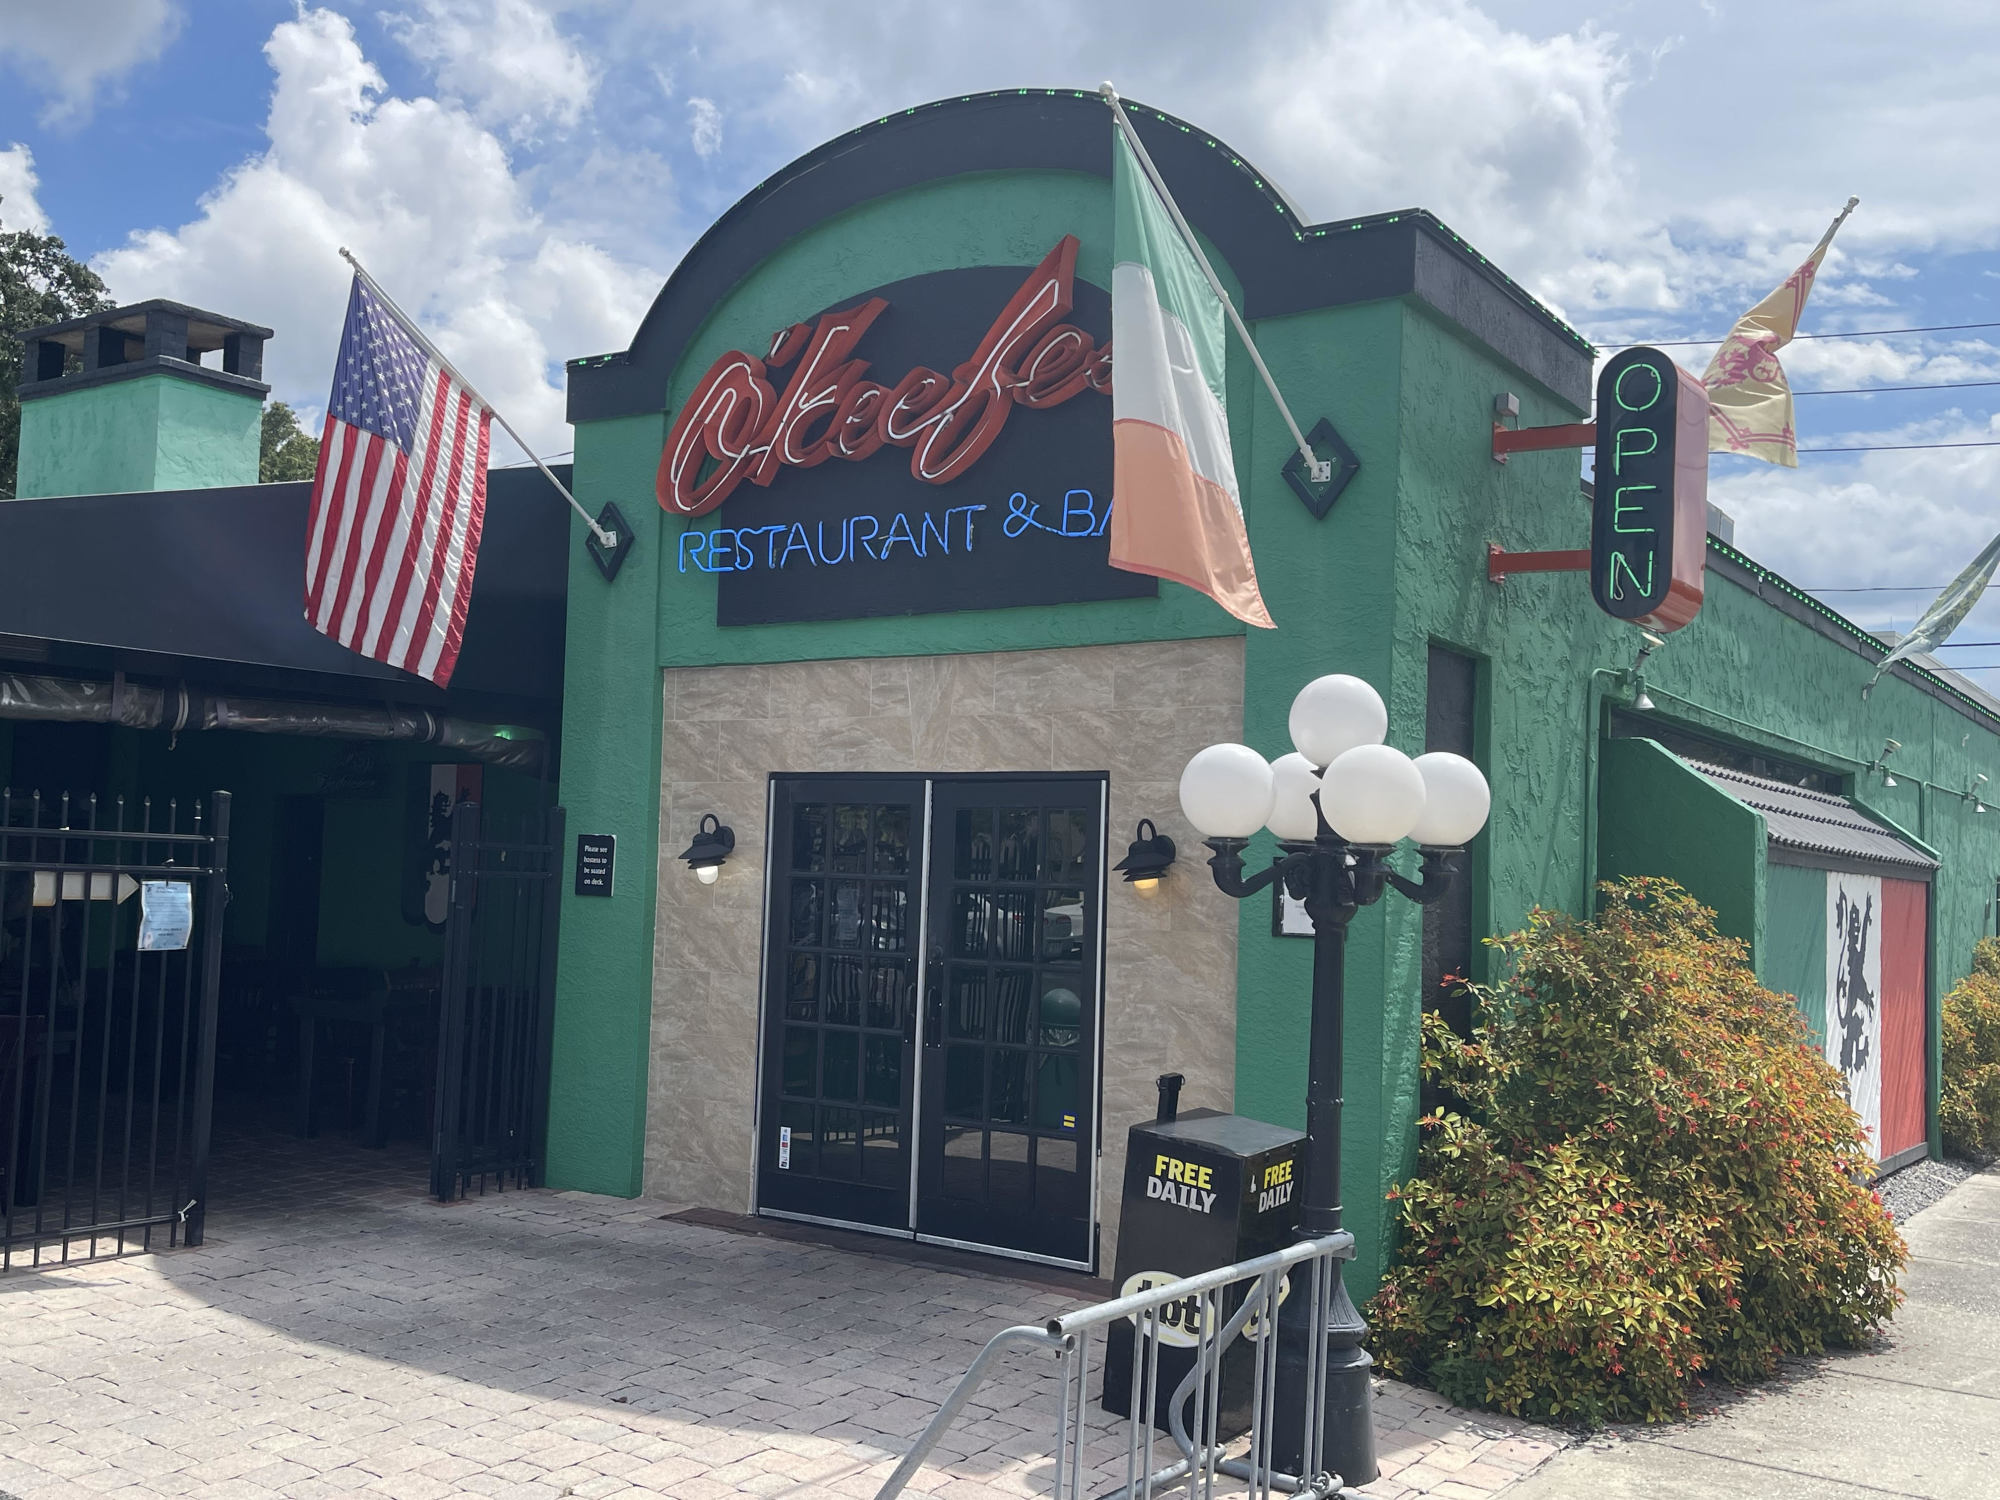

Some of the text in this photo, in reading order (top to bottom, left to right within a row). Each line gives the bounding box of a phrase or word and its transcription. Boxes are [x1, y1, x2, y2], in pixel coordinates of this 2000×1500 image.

[1610, 362, 1662, 601] OPEN
[678, 503, 988, 573] RESTAURANT
[1003, 491, 1040, 538] &
[1154, 1154, 1213, 1191] FREE
[1263, 1159, 1294, 1189] FREE
[1146, 1176, 1217, 1214] DAILY
[1258, 1180, 1295, 1214] DAILY
